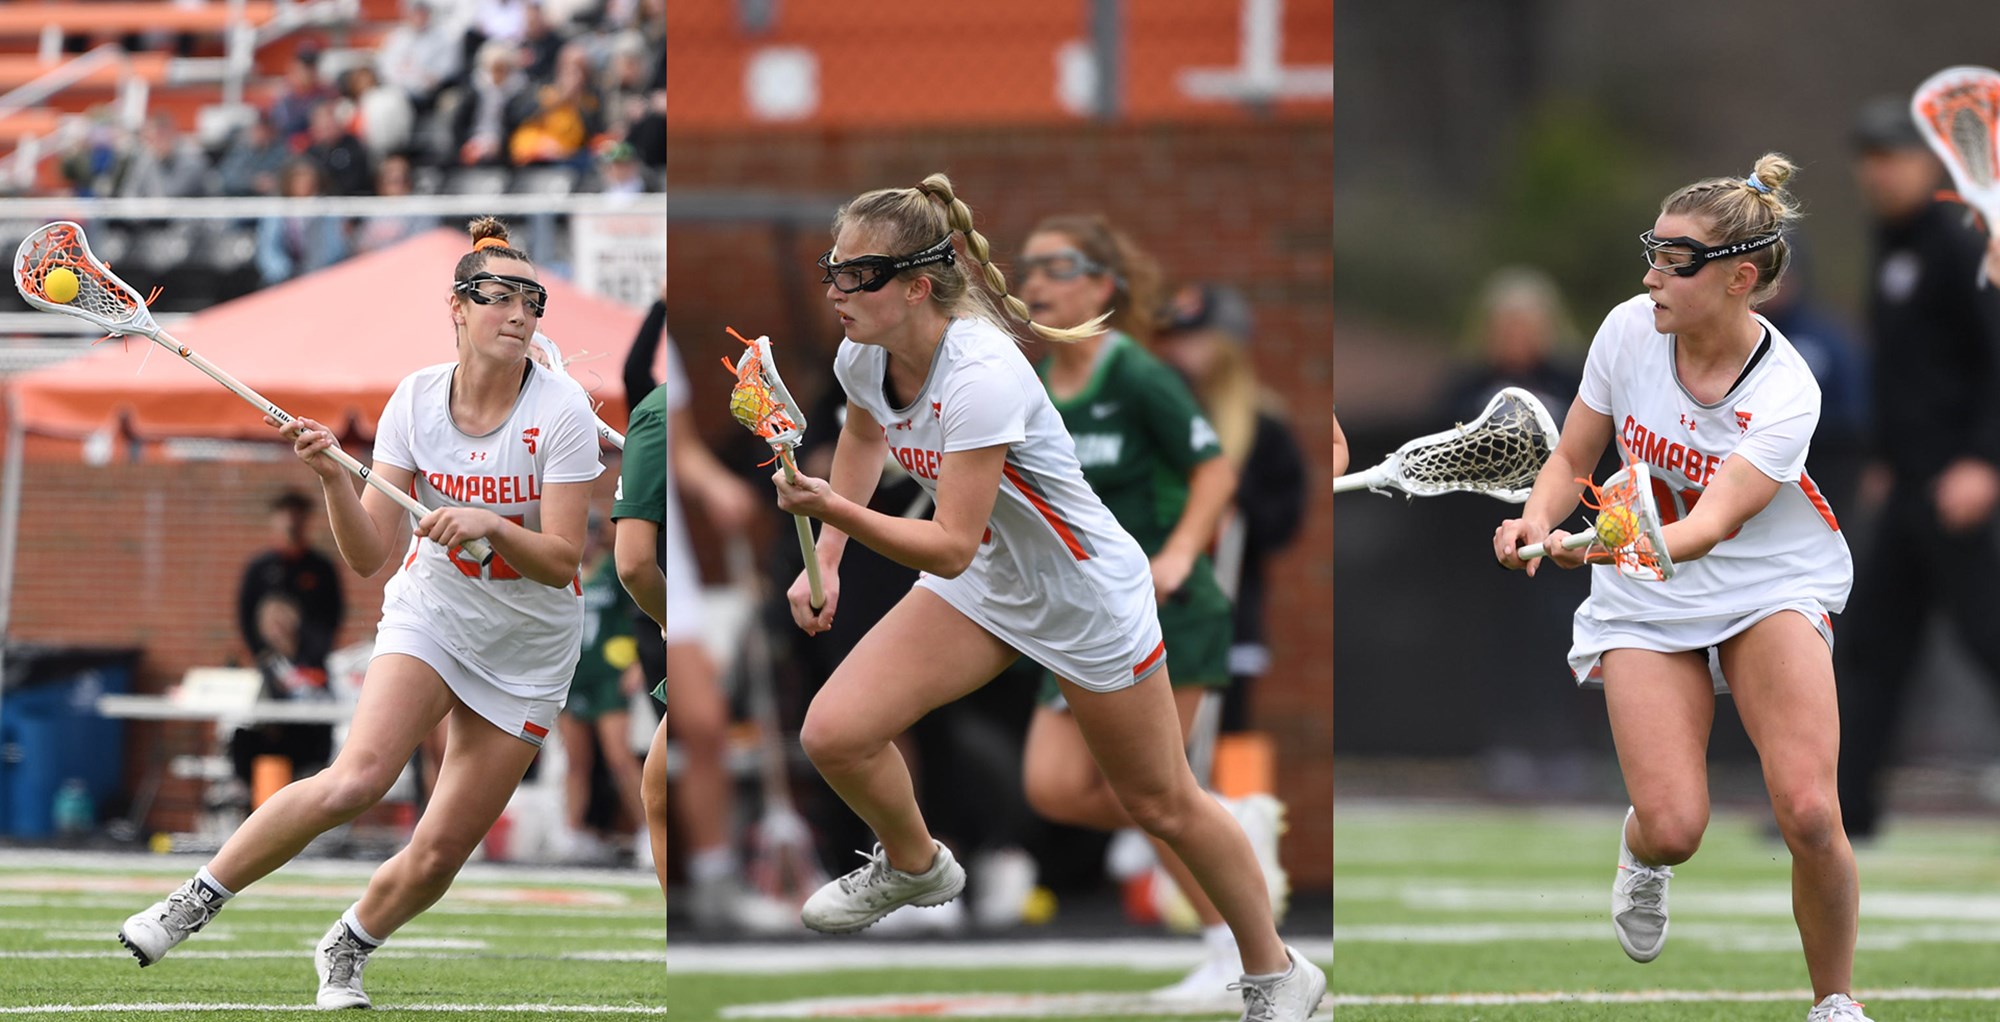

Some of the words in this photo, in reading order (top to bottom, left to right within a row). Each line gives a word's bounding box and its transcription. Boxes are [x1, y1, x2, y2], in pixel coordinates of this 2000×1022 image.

[1706, 248, 1729, 258] OUR
[1622, 414, 1725, 487] CAMPBE
[418, 469, 541, 504] AMPBELL
